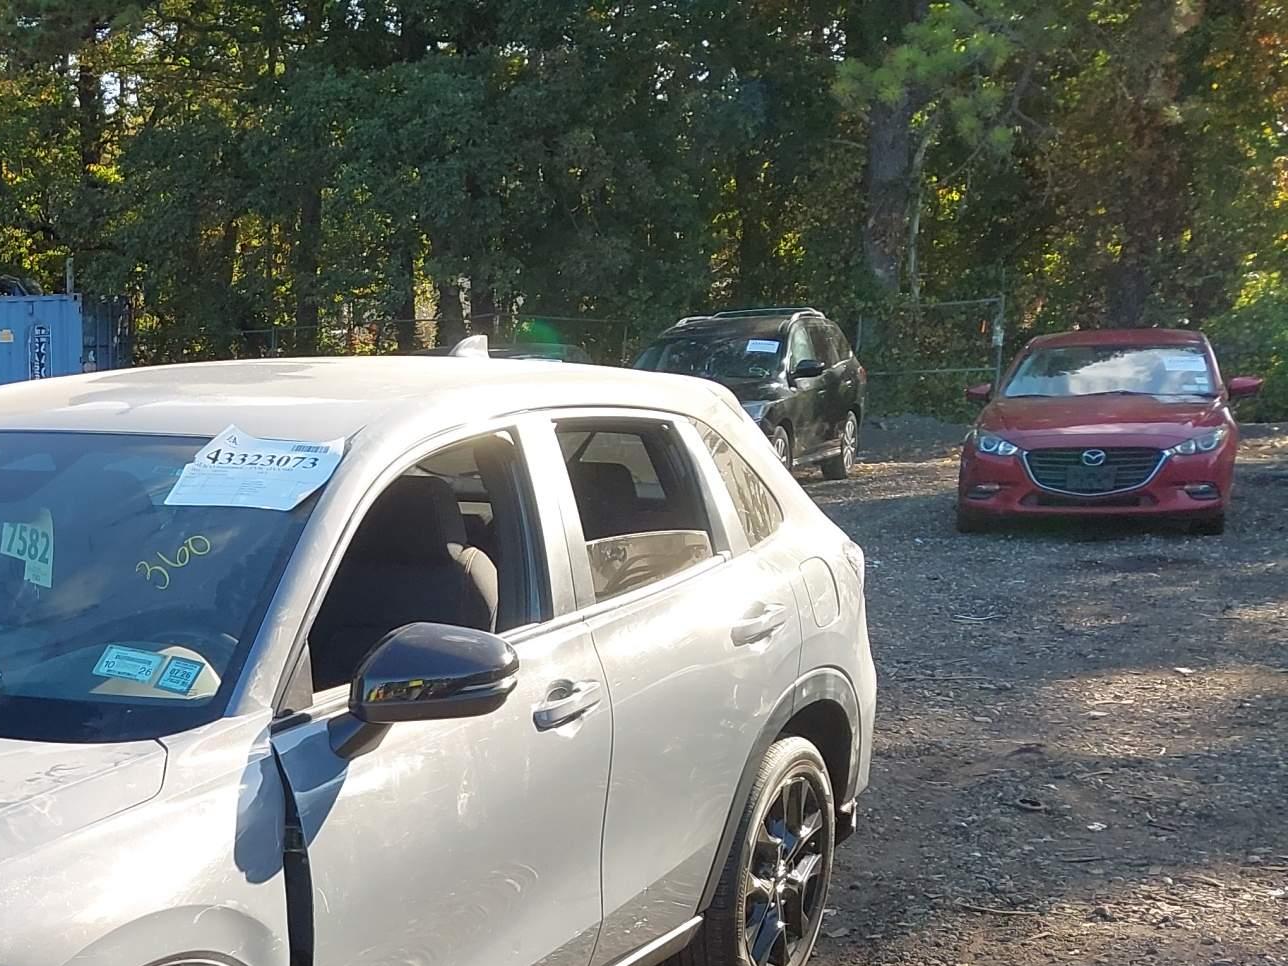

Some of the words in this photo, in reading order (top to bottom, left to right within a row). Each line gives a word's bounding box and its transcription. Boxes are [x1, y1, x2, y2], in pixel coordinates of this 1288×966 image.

[206, 448, 320, 468] 43323073
[6, 523, 50, 565] 7582
[135, 535, 211, 590] 360
[104, 660, 116, 669] 10
[138, 666, 153, 676] 26
